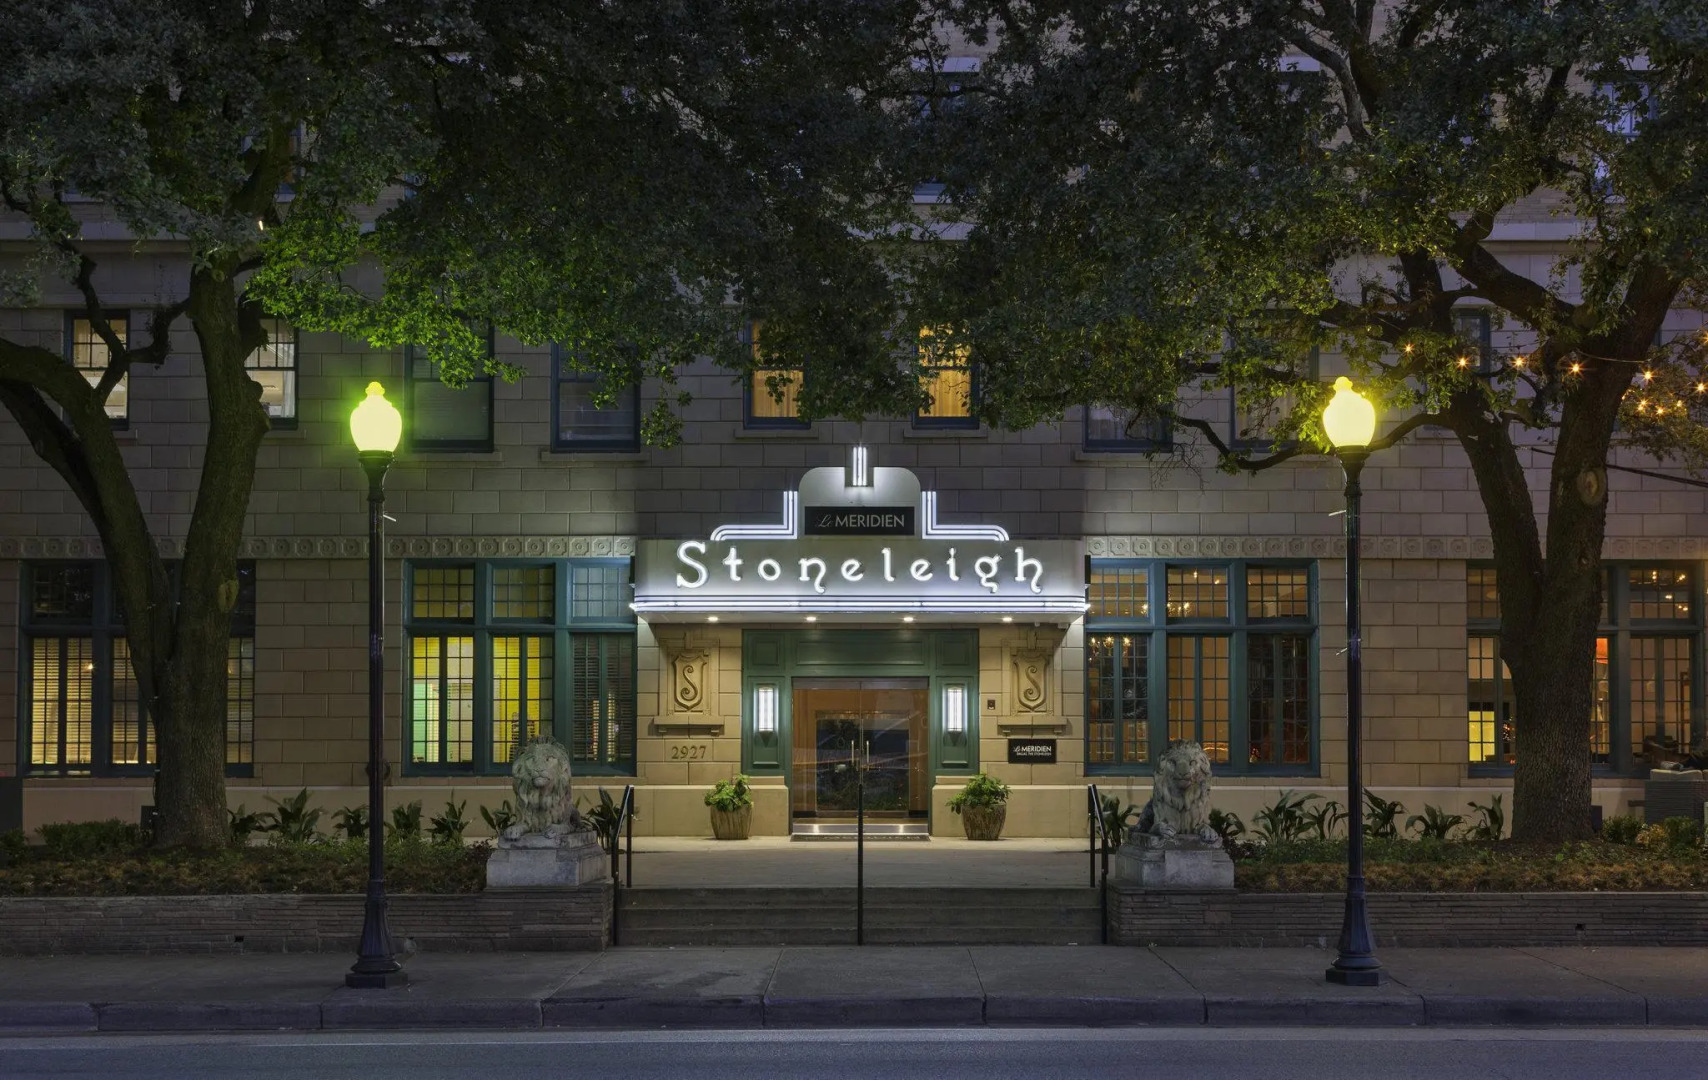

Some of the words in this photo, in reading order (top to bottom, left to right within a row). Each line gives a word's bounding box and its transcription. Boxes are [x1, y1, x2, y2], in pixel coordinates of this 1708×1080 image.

[816, 514, 833, 528] Le
[835, 514, 905, 528] MERIDIEN
[676, 540, 1043, 594] Stoneleigh
[671, 745, 707, 760] 2927
